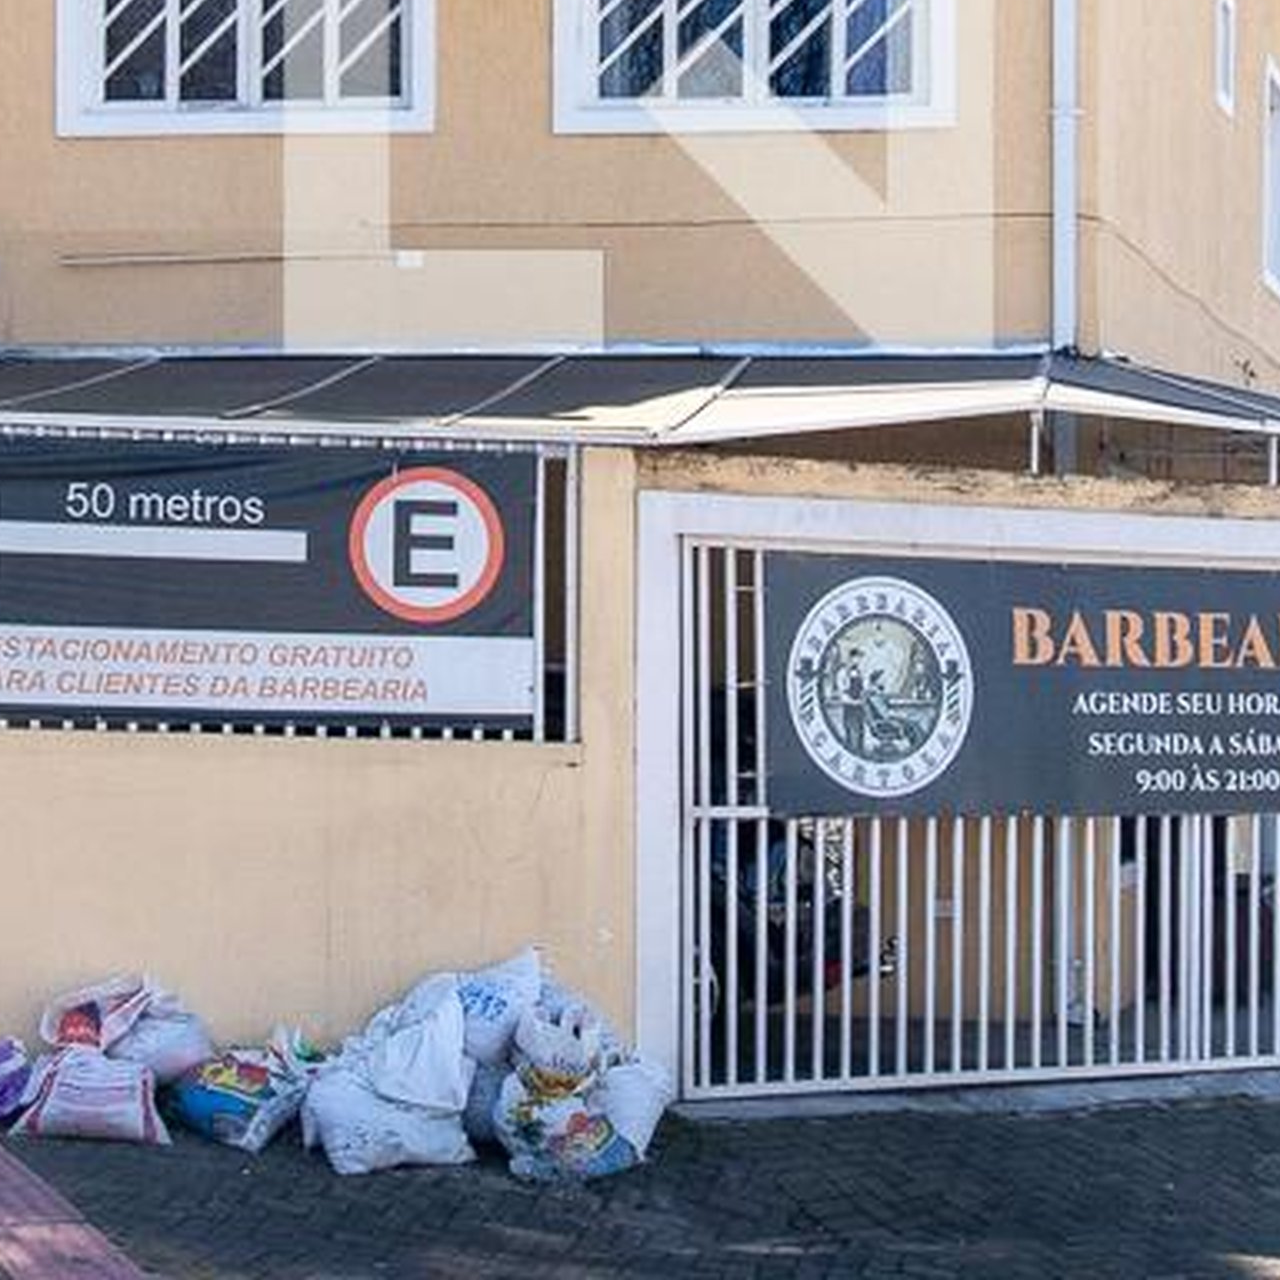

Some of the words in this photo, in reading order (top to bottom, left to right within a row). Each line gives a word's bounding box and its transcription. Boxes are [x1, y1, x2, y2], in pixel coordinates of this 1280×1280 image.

[66, 482, 115, 518] 50
[129, 488, 265, 524] metros
[392, 499, 460, 589] E
[269, 643, 414, 669] GRATUITO
[56, 670, 202, 697] CLIENTES
[209, 675, 249, 698] DA
[258, 676, 428, 702] BARBEARIA
[1072, 691, 1172, 715] AGENDE
[1176, 691, 1222, 715] SEU
[1088, 732, 1204, 756] SEGUNDA
[1208, 734, 1225, 755] A
[1136, 769, 1187, 793] 9:00
[1190, 762, 1220, 791] ÀS
[1224, 769, 1280, 792] 21:00
